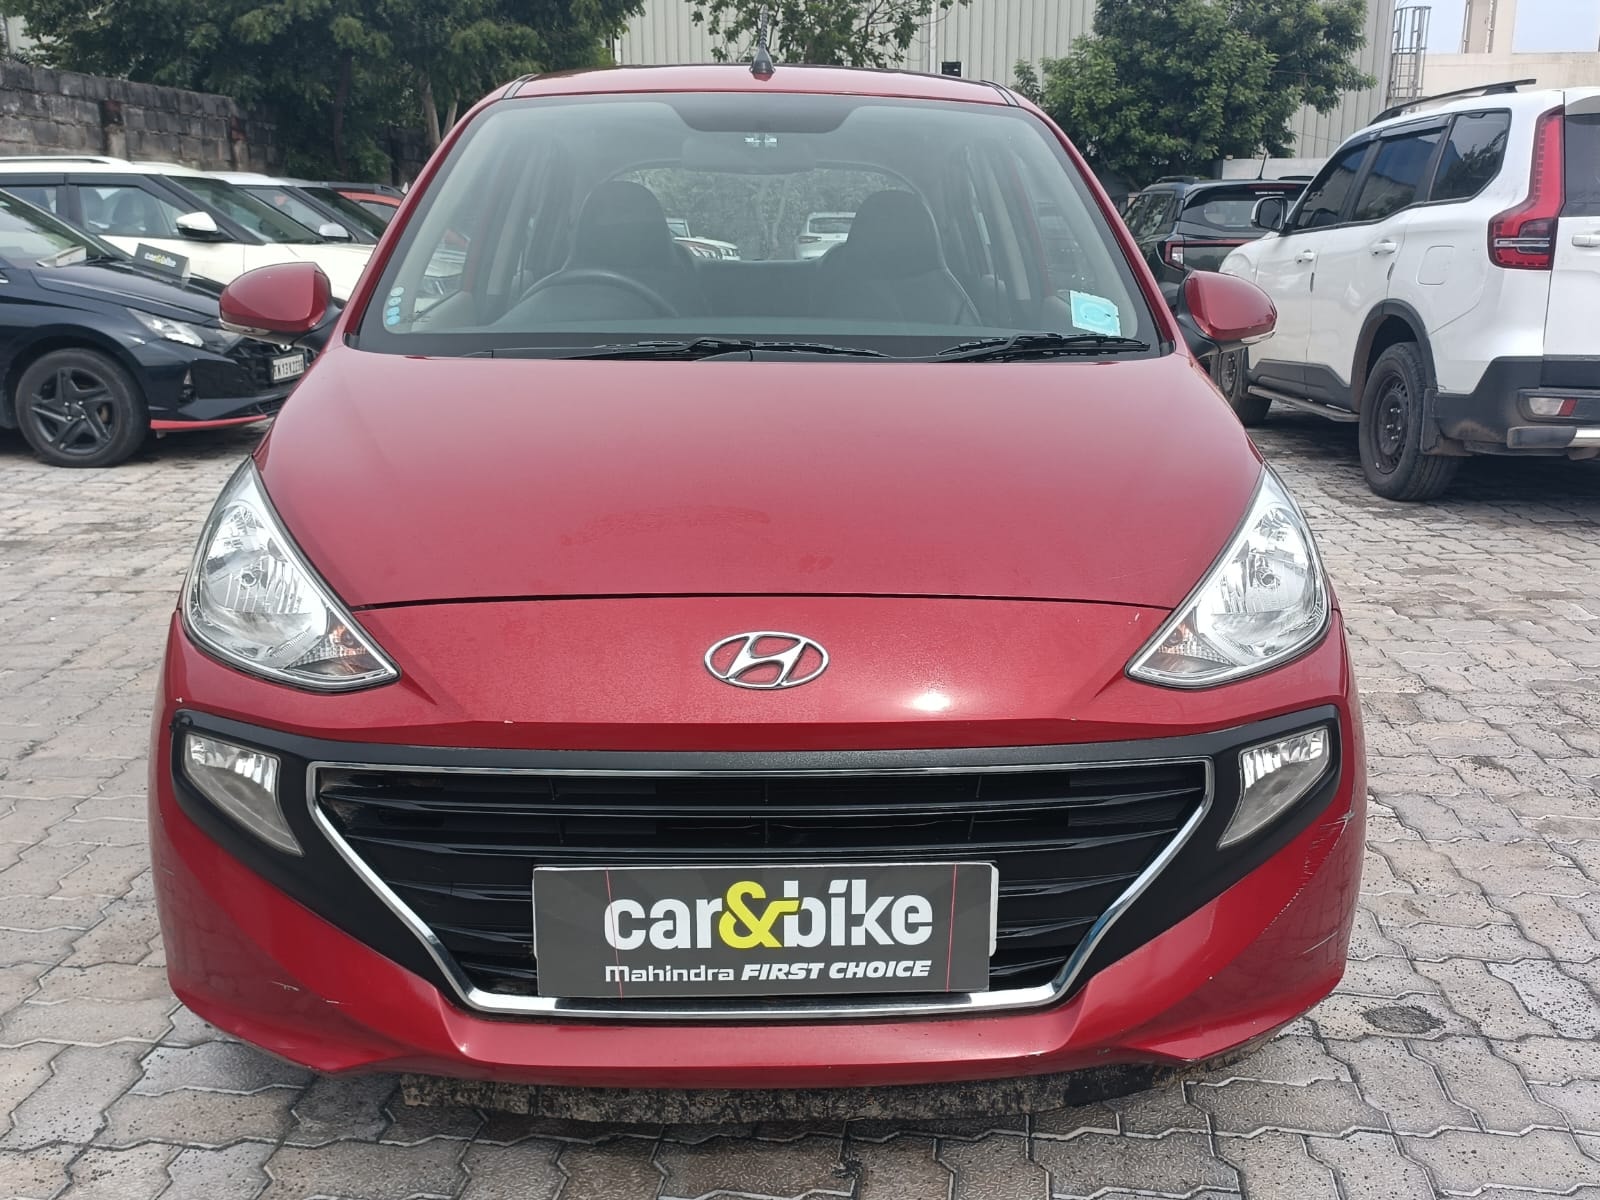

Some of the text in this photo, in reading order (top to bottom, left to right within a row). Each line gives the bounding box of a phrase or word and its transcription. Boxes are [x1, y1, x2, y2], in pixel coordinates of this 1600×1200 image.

[604, 879, 933, 951] car&bike
[605, 960, 932, 982] Mahindra FIRST CHOICE
